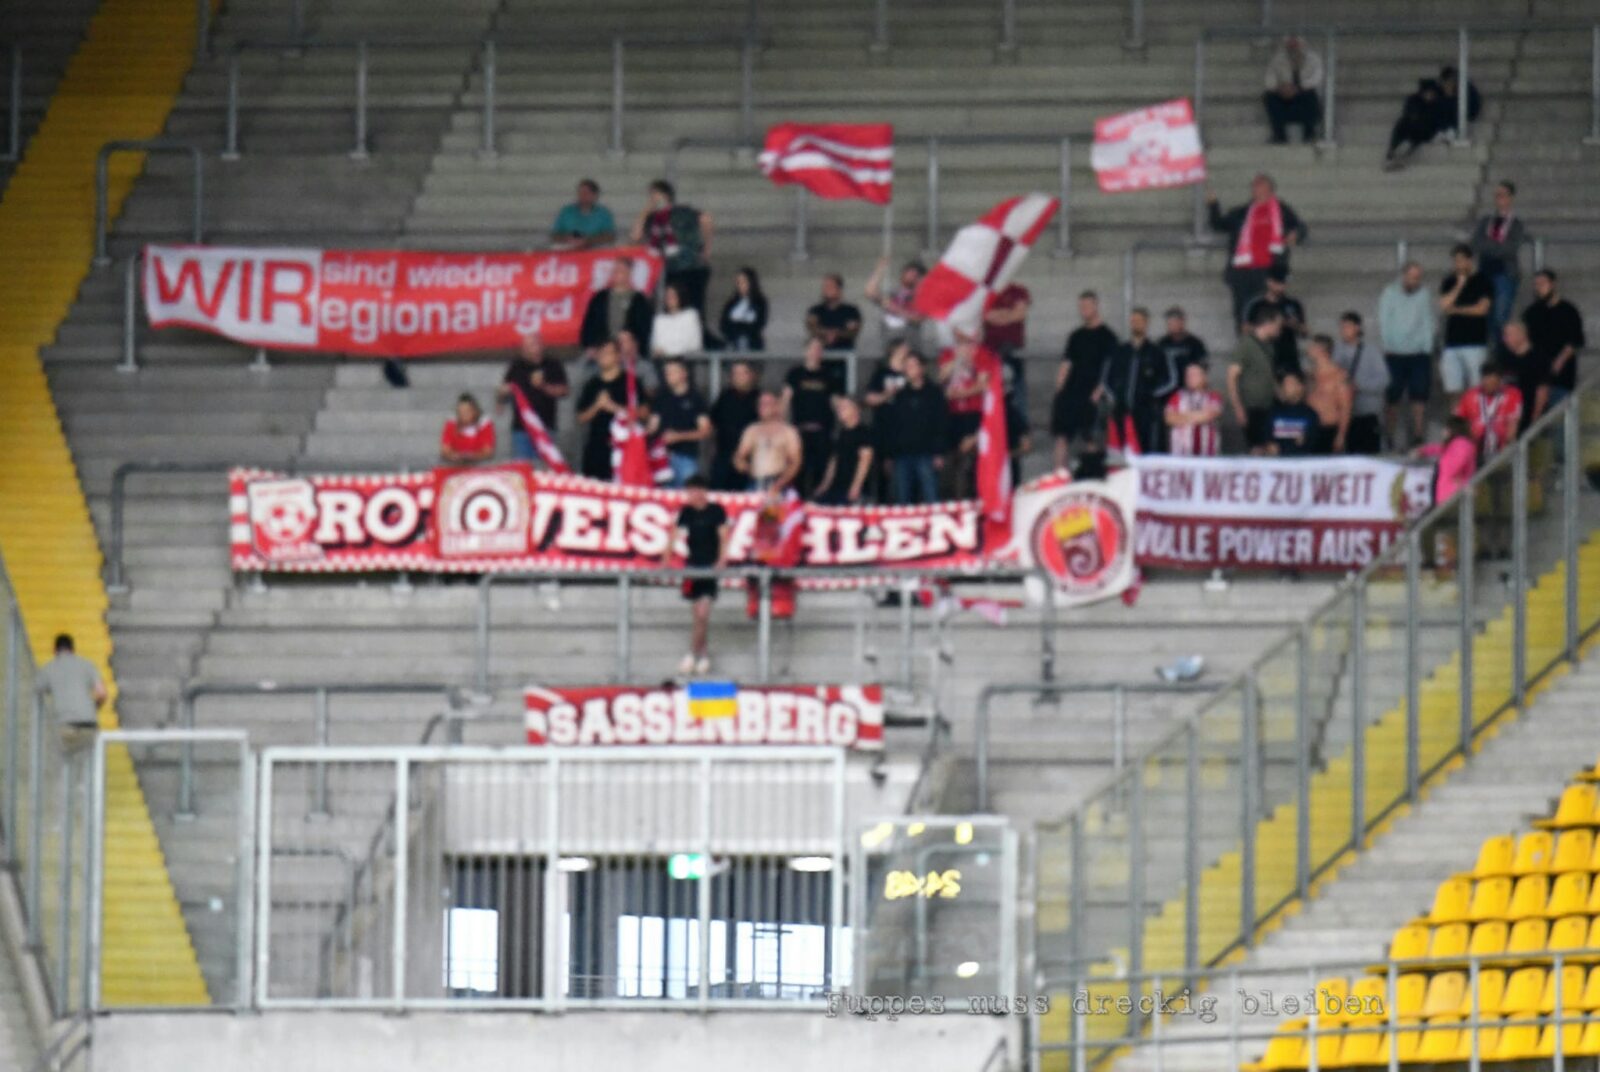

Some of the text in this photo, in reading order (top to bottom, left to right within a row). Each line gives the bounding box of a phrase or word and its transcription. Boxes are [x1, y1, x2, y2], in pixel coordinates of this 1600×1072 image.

[152, 254, 317, 324] WIR
[322, 256, 579, 288] sind wieder da
[1203, 469, 1260, 504] WEG
[1267, 470, 1303, 505] ZU
[1311, 472, 1375, 506] WEIT
[314, 487, 434, 544] RO
[1218, 526, 1314, 565] POWER
[1318, 529, 1373, 566] AUS
